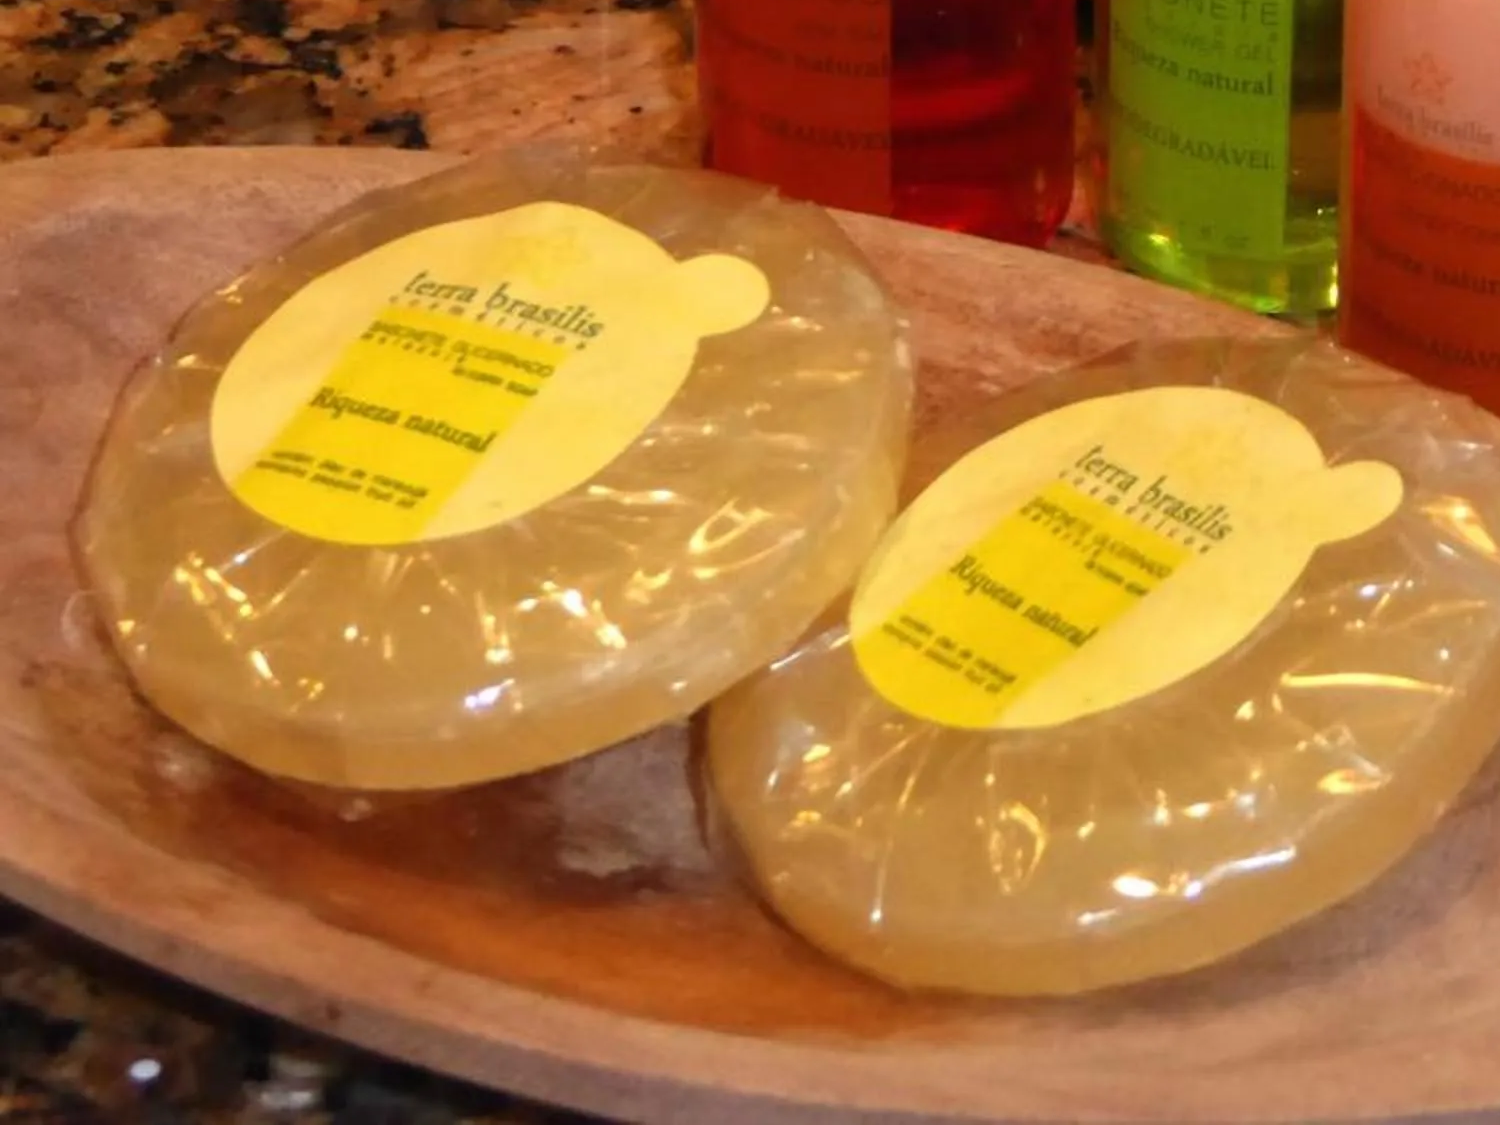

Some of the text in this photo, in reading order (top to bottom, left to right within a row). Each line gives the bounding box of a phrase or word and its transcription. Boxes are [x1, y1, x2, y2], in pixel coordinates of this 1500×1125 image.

[1187, 65, 1274, 97] natural
[403, 270, 605, 339] terra brasilis
[308, 386, 498, 453] Riqueza natural
[1075, 445, 1139, 493] terra
[1138, 474, 1233, 542] brasilis
[949, 554, 1024, 611] Riqueza
[1021, 604, 1100, 649] natural
